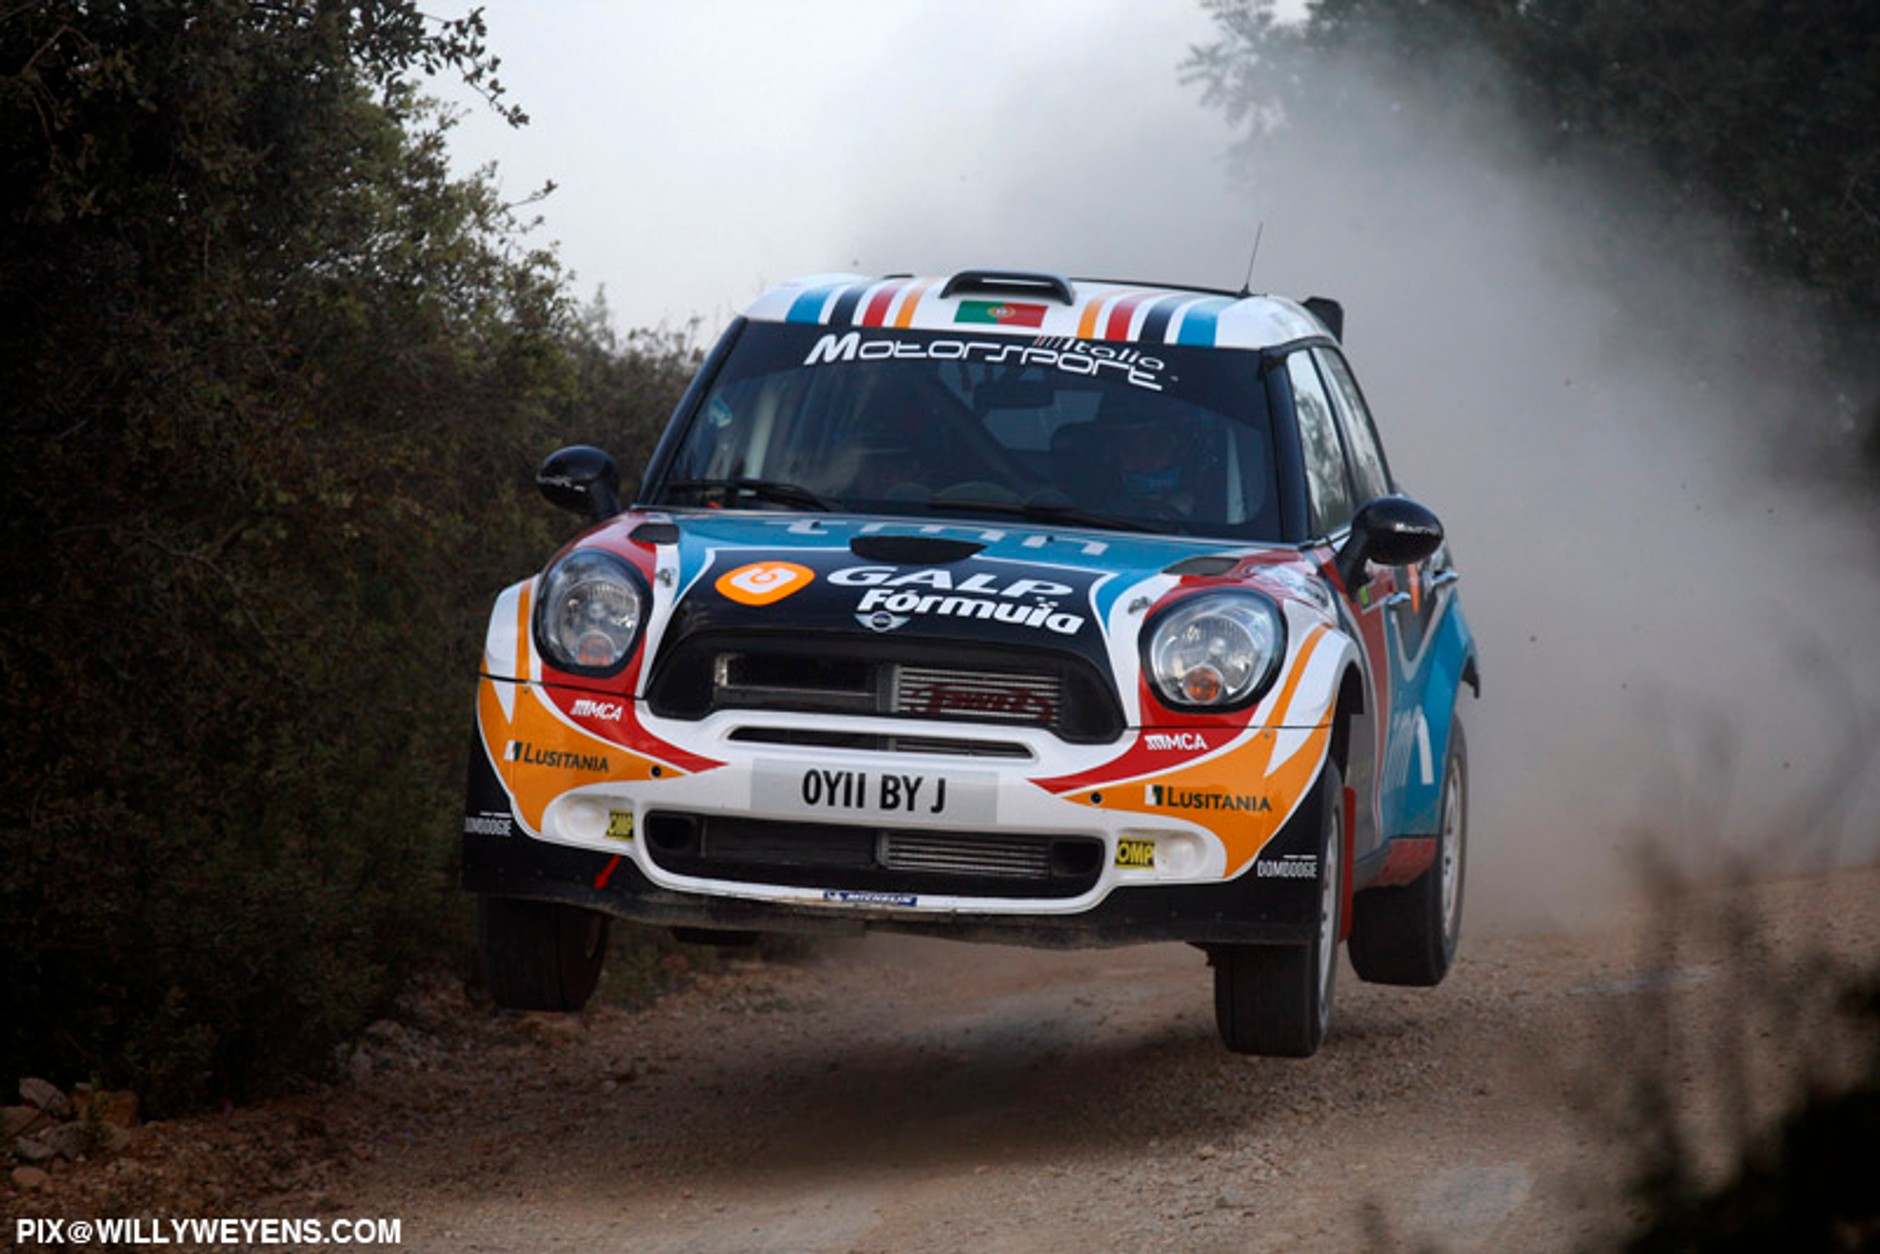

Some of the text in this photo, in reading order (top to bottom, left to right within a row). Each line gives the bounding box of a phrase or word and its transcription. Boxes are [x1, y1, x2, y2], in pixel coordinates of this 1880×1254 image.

[803, 332, 1163, 391] Motorsport
[826, 565, 1074, 598] GALP
[1166, 732, 1209, 750] MCA
[1167, 784, 1273, 812] LUSITANIA
[1117, 842, 1153, 865] OMP
